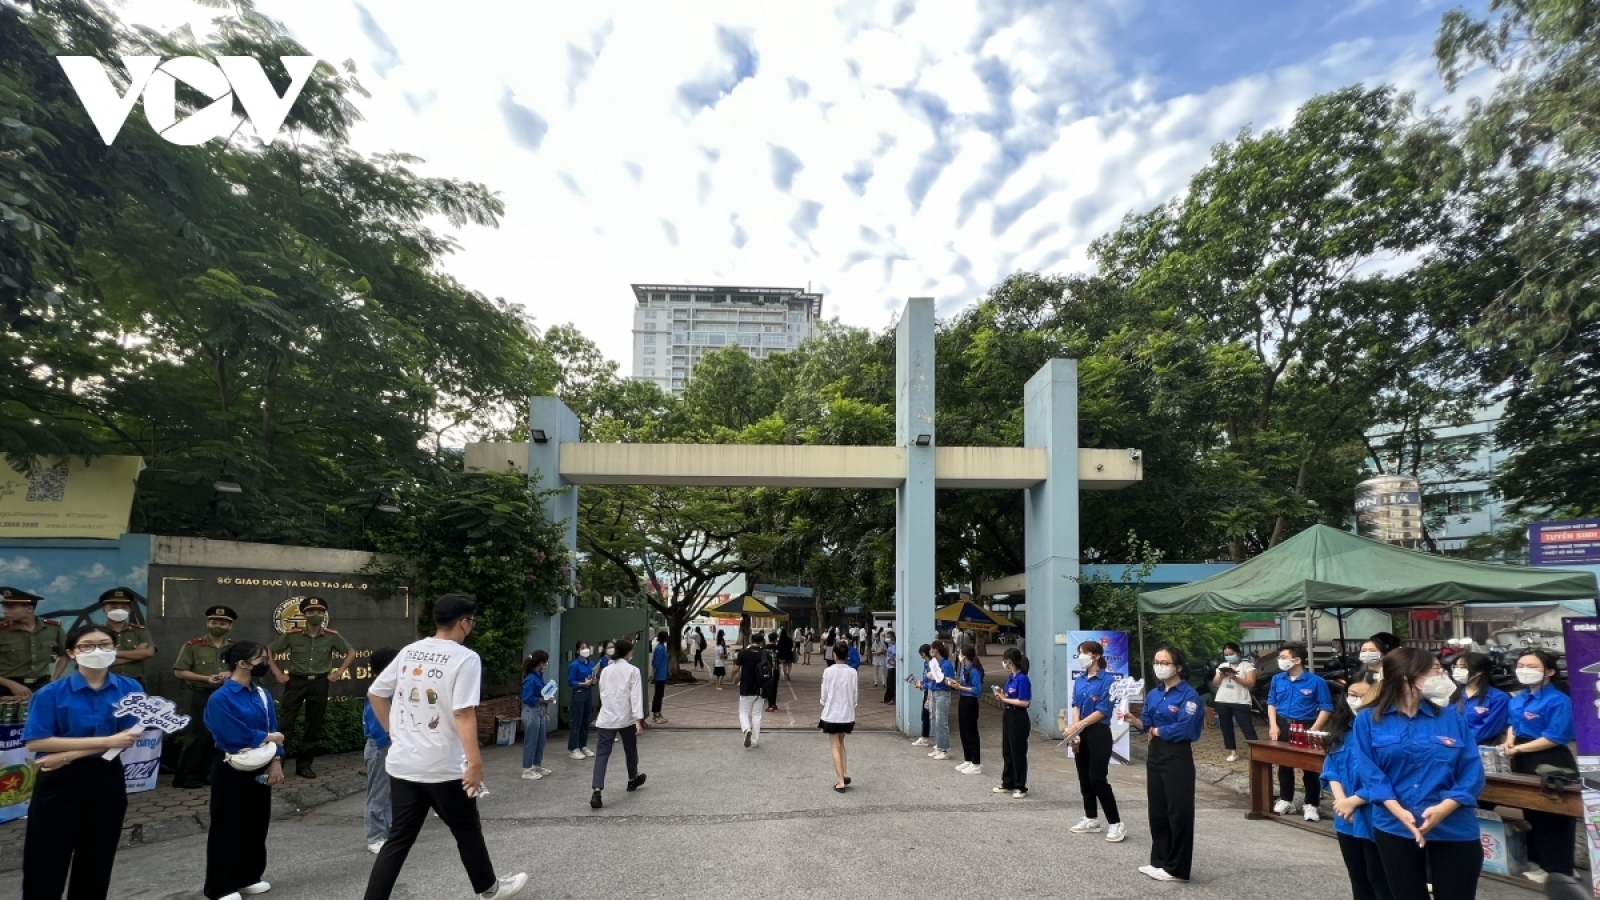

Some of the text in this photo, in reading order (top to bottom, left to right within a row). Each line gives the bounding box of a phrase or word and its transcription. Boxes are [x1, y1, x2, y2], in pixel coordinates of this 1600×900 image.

[117, 706, 149, 718] for
[123, 696, 188, 726] Good luck
